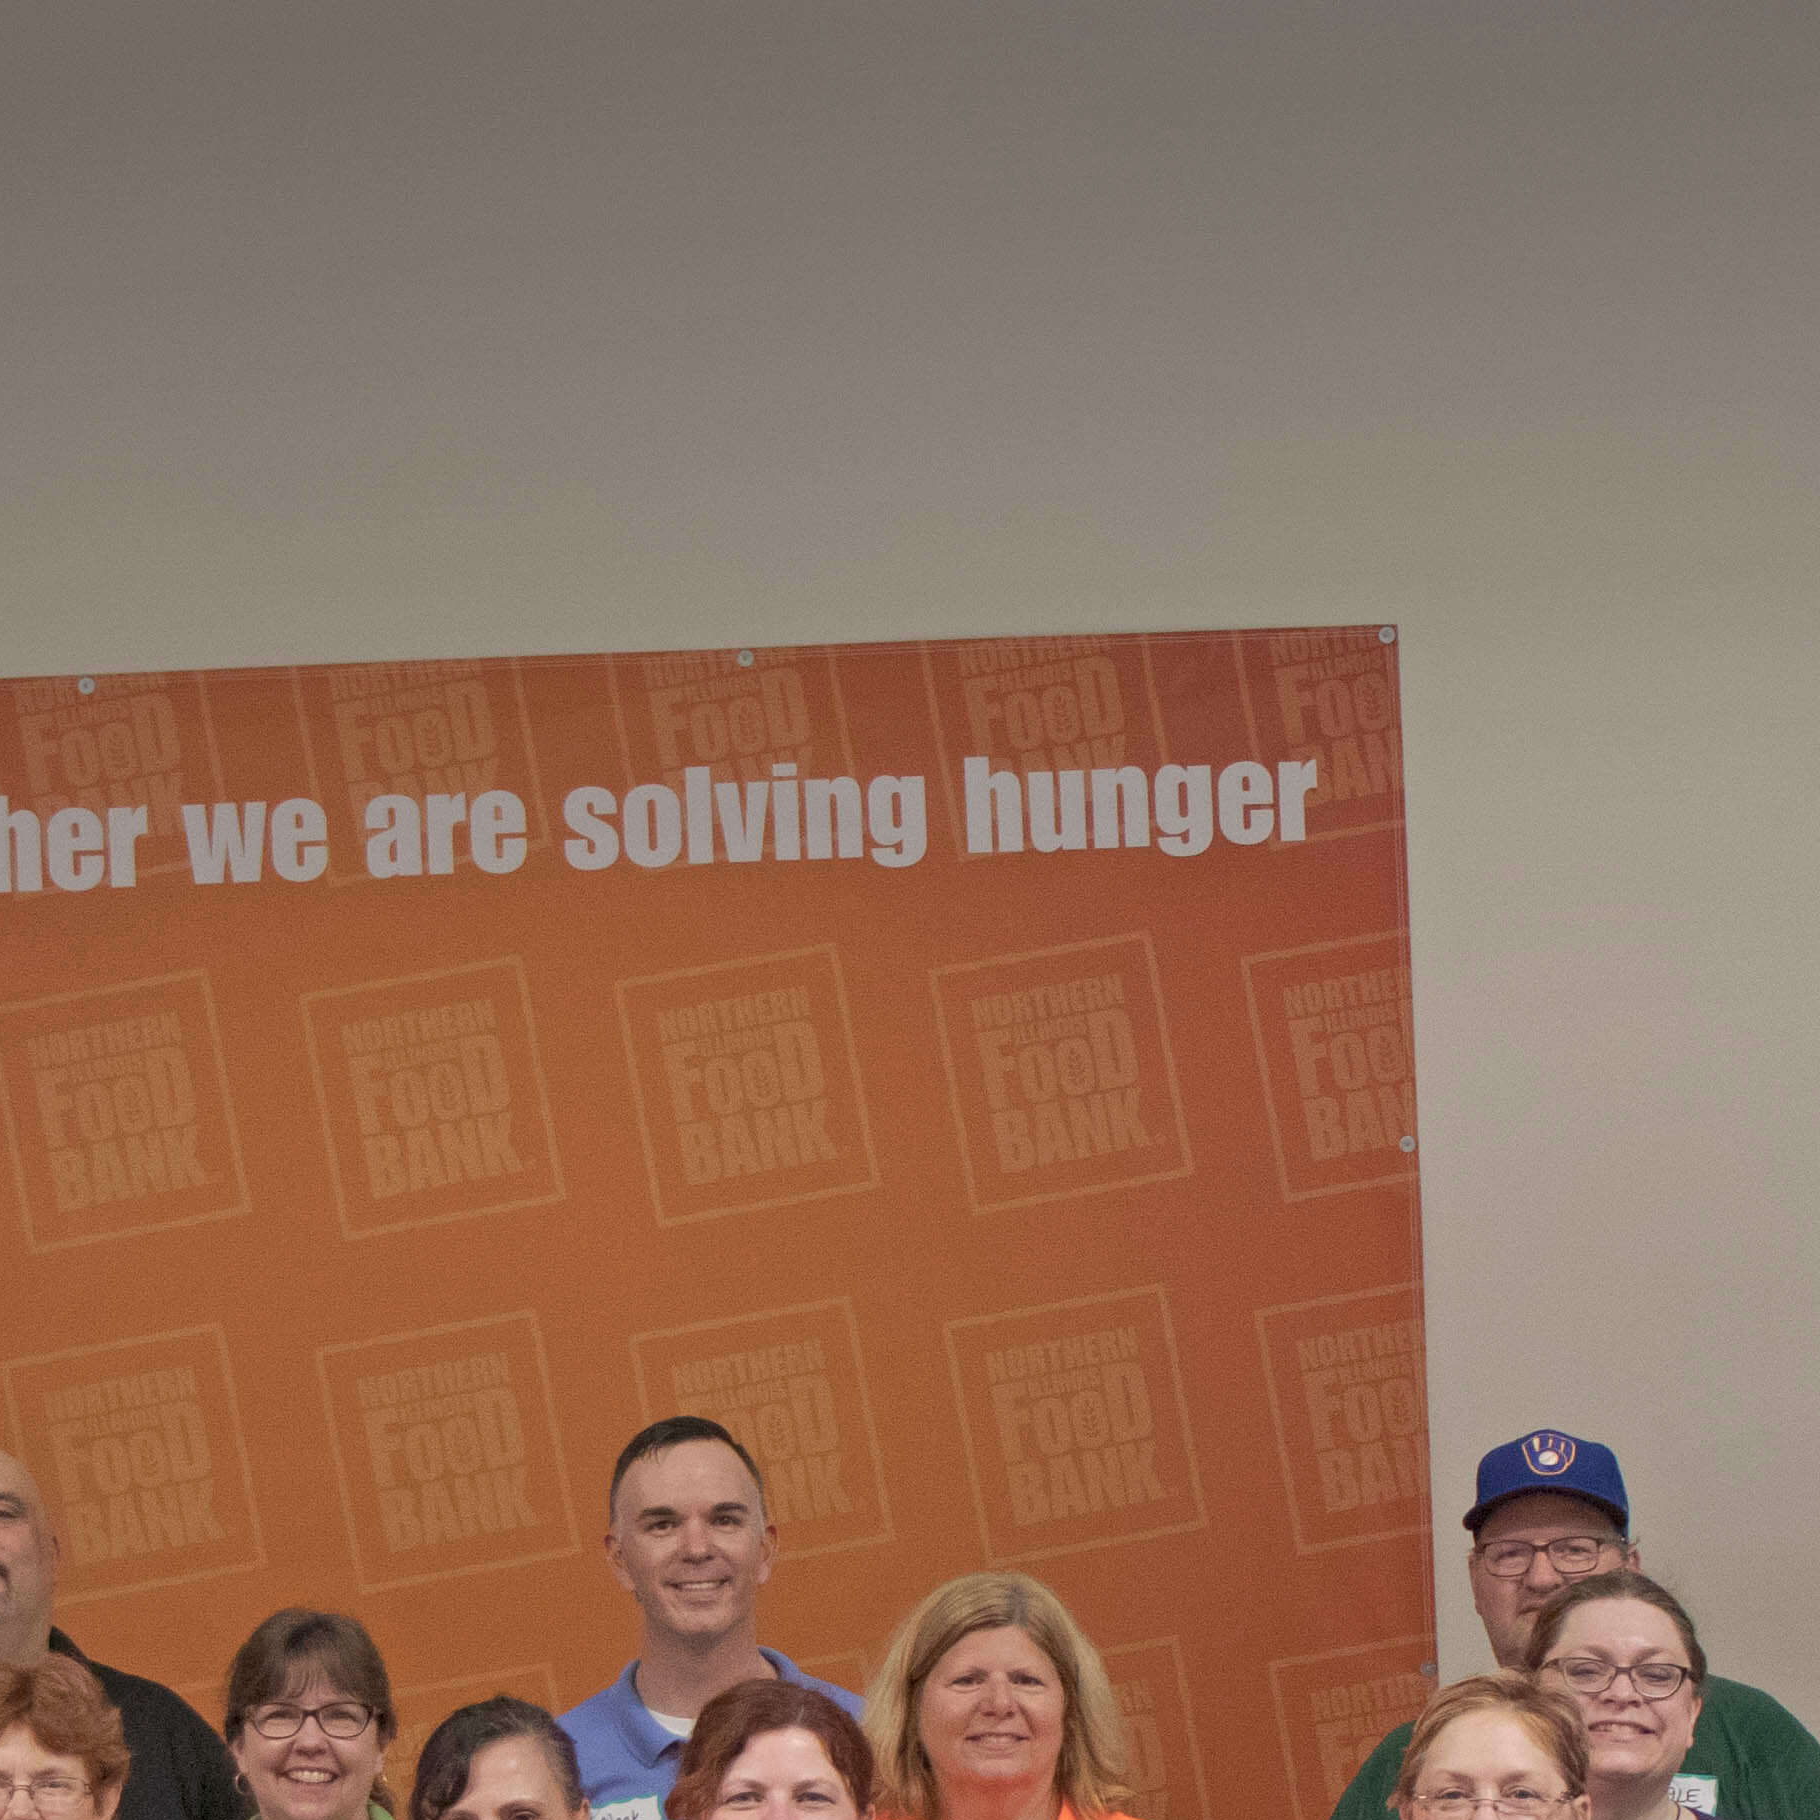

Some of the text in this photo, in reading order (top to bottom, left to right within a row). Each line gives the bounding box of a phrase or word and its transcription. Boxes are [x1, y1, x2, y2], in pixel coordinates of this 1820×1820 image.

[181, 797, 328, 887] we
[364, 789, 528, 879] are
[564, 763, 928, 872] solving
[964, 756, 1318, 858] hunger
[978, 1009, 1140, 1113] FOOD
[993, 1085, 1153, 1175] BANK
